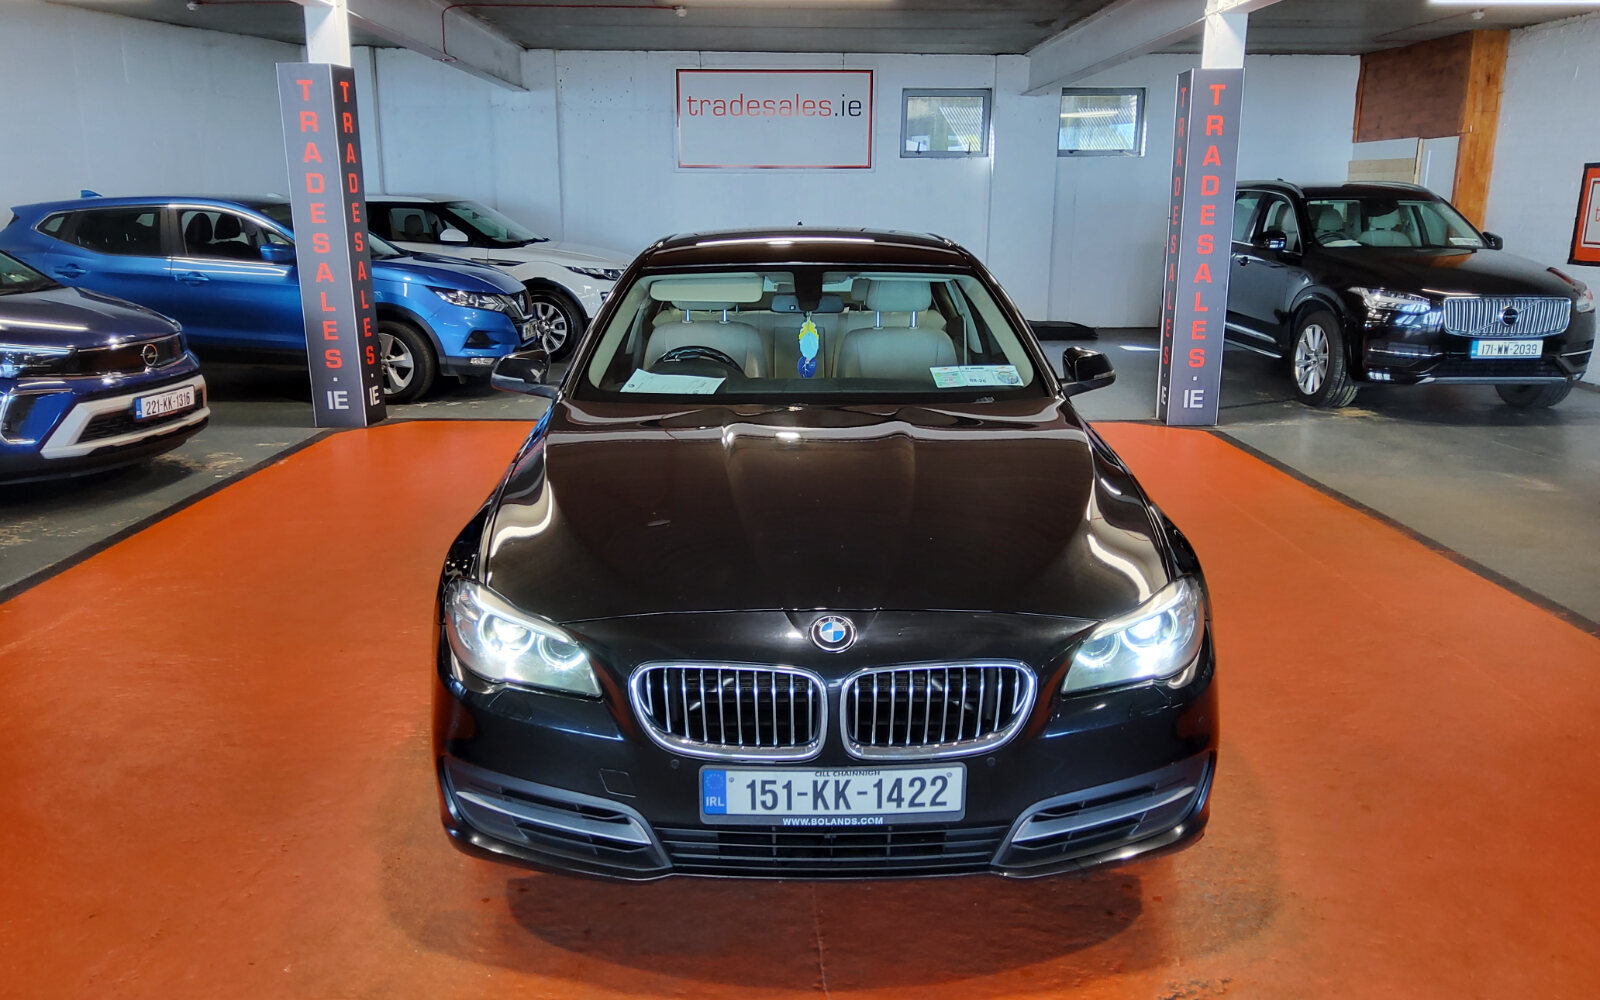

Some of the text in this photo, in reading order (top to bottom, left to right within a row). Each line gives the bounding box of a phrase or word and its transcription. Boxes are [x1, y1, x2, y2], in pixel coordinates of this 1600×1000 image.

[686, 93, 862, 117] tradesales.ie
[146, 391, 191, 415] 221-KK-1316
[706, 775, 949, 811] IRL 151-KK-1422
[782, 816, 884, 826] WWW.BOLANDS.COM
